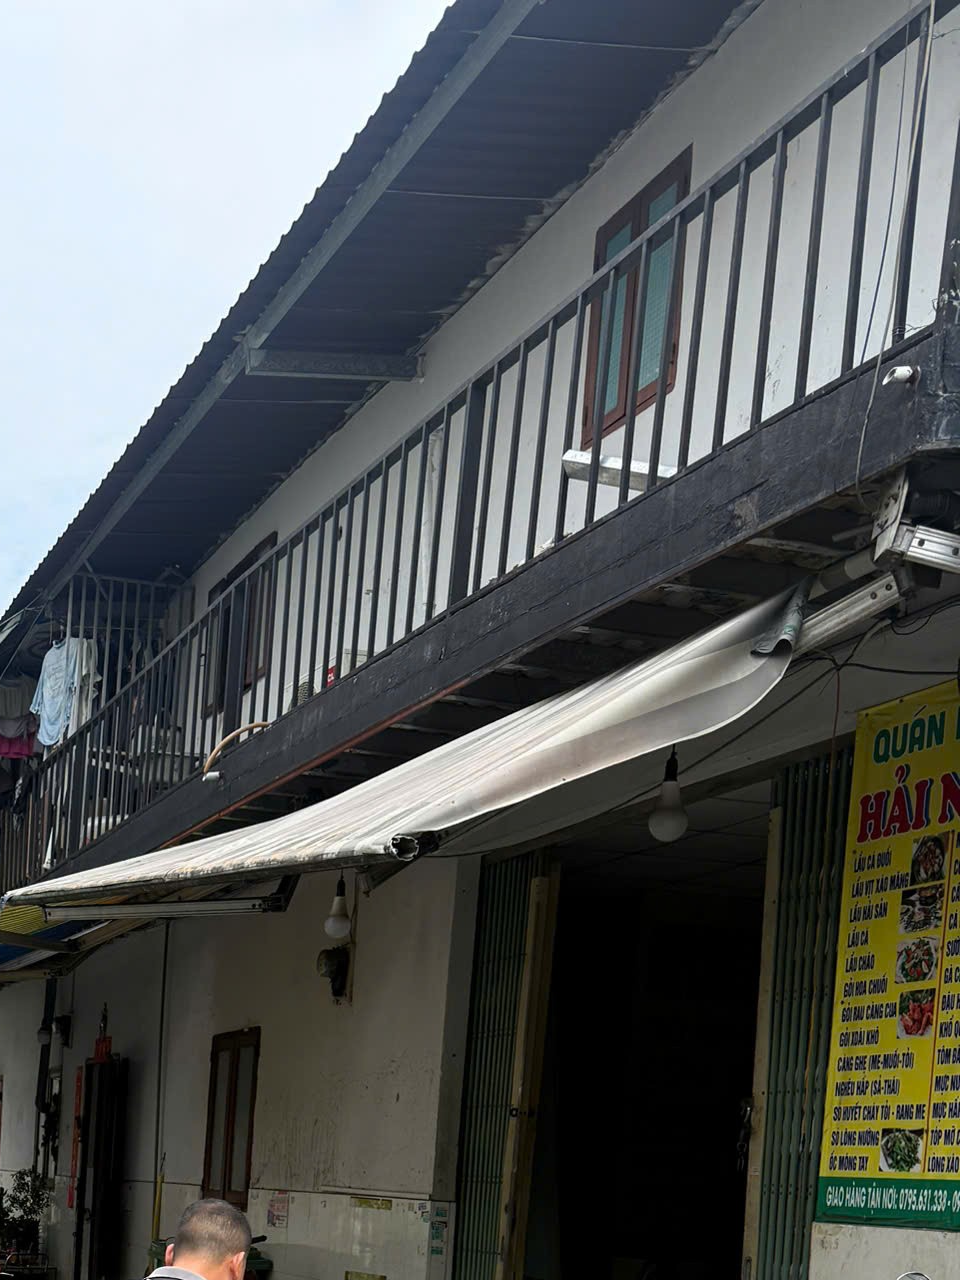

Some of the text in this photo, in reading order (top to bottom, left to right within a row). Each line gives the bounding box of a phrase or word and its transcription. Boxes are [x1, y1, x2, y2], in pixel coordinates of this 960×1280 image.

[873, 705, 945, 764] QUÁN
[856, 764, 933, 843] HẢI
[867, 851, 876, 870] CÁ
[885, 1002, 897, 1018] CUA
[895, 1103, 914, 1120] RANG
[915, 1103, 927, 1120] ME
[858, 1156, 869, 1171] TAY
[825, 1185, 845, 1207] GIAO
[844, 1180, 867, 1208] HÀNG
